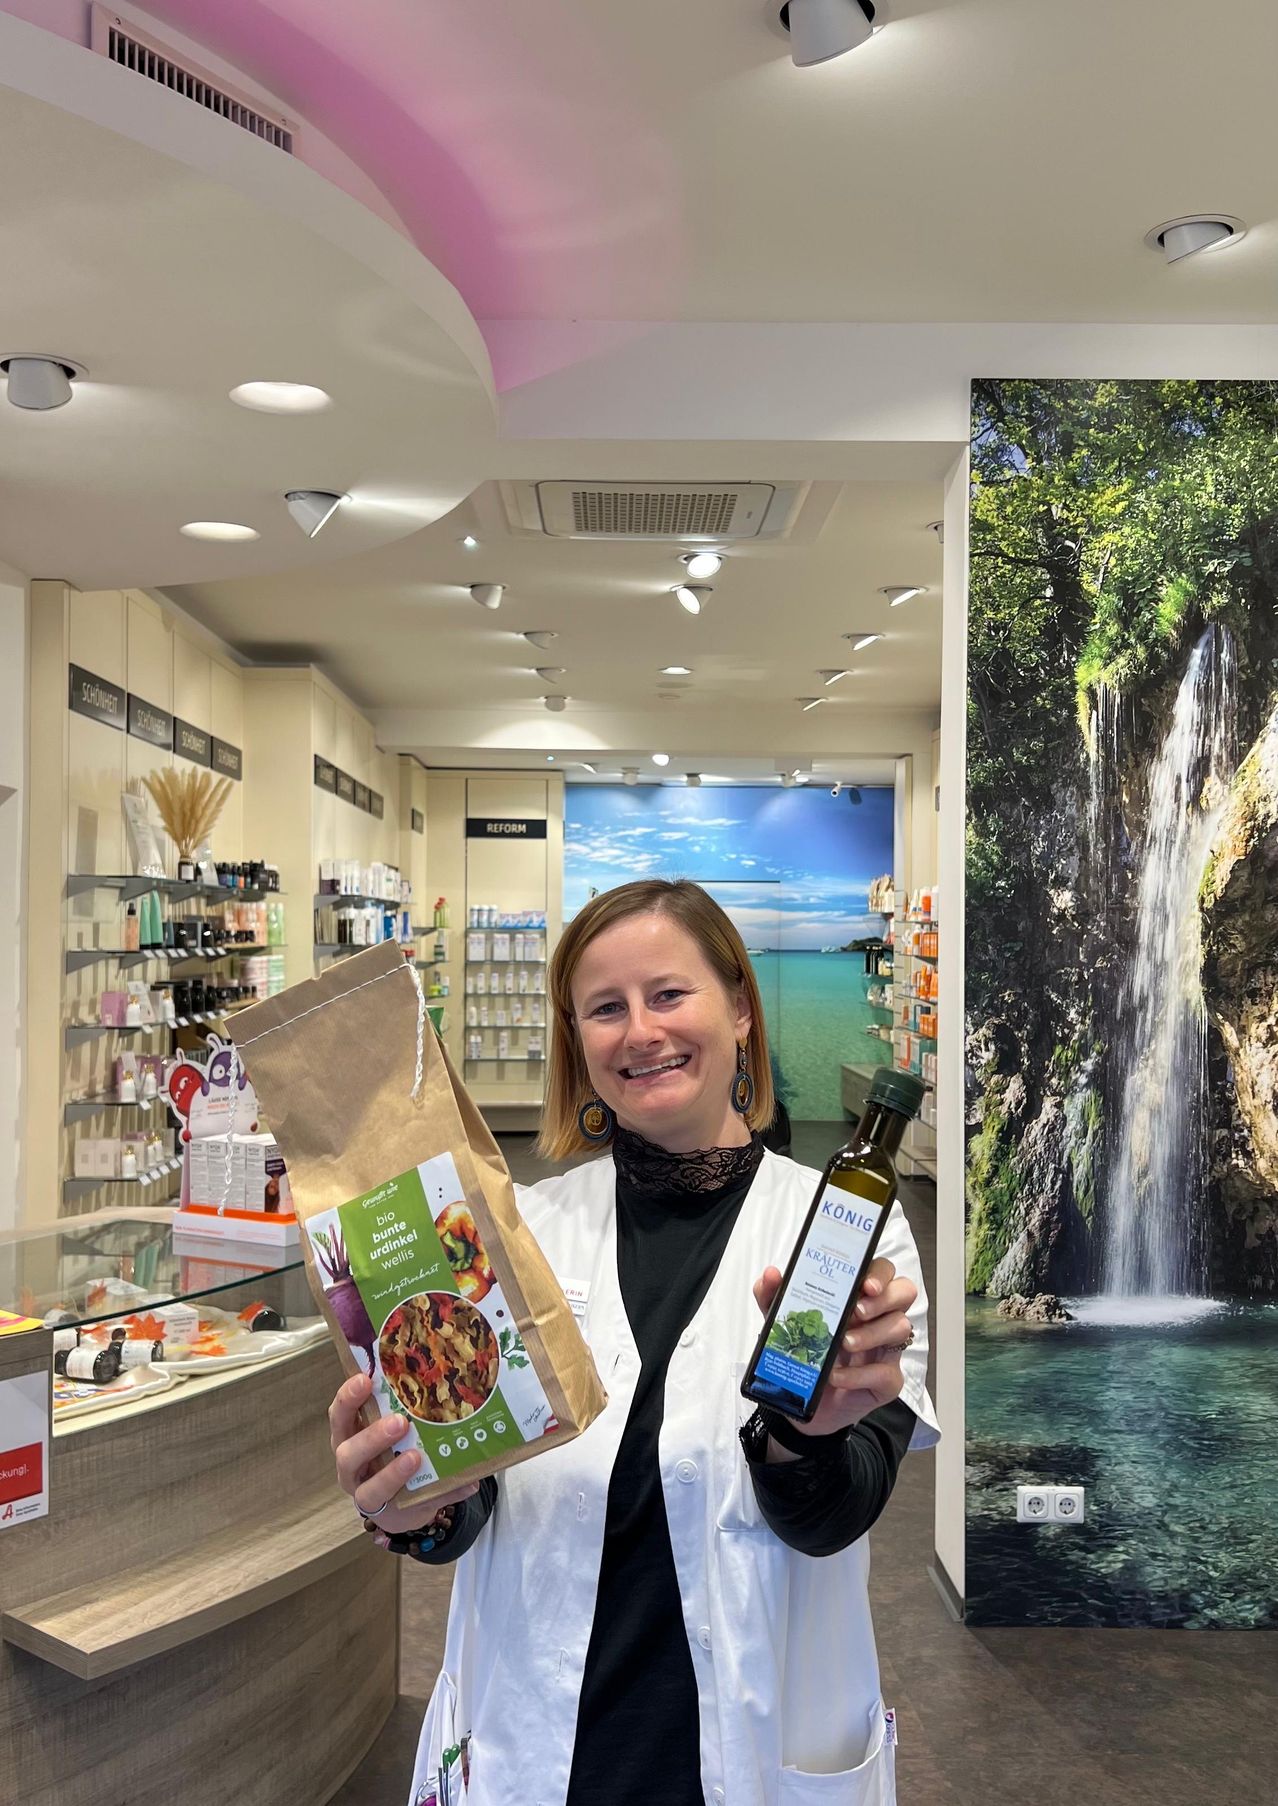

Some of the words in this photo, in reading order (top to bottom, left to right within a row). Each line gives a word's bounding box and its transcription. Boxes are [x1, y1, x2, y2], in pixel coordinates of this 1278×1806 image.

[82, 682, 118, 714] SCHÖNHEIT
[137, 709, 166, 737] SCHÖNHEIT
[486, 823, 527, 834] REFORM
[376, 1210, 396, 1227] bio
[821, 1200, 874, 1231] KÖNIG
[372, 1219, 407, 1244] bunte
[369, 1232, 418, 1261] urdinkel
[380, 1249, 415, 1270] wellis
[371, 1262, 441, 1302] windgetrocknet
[819, 1263, 836, 1279] ÖL
